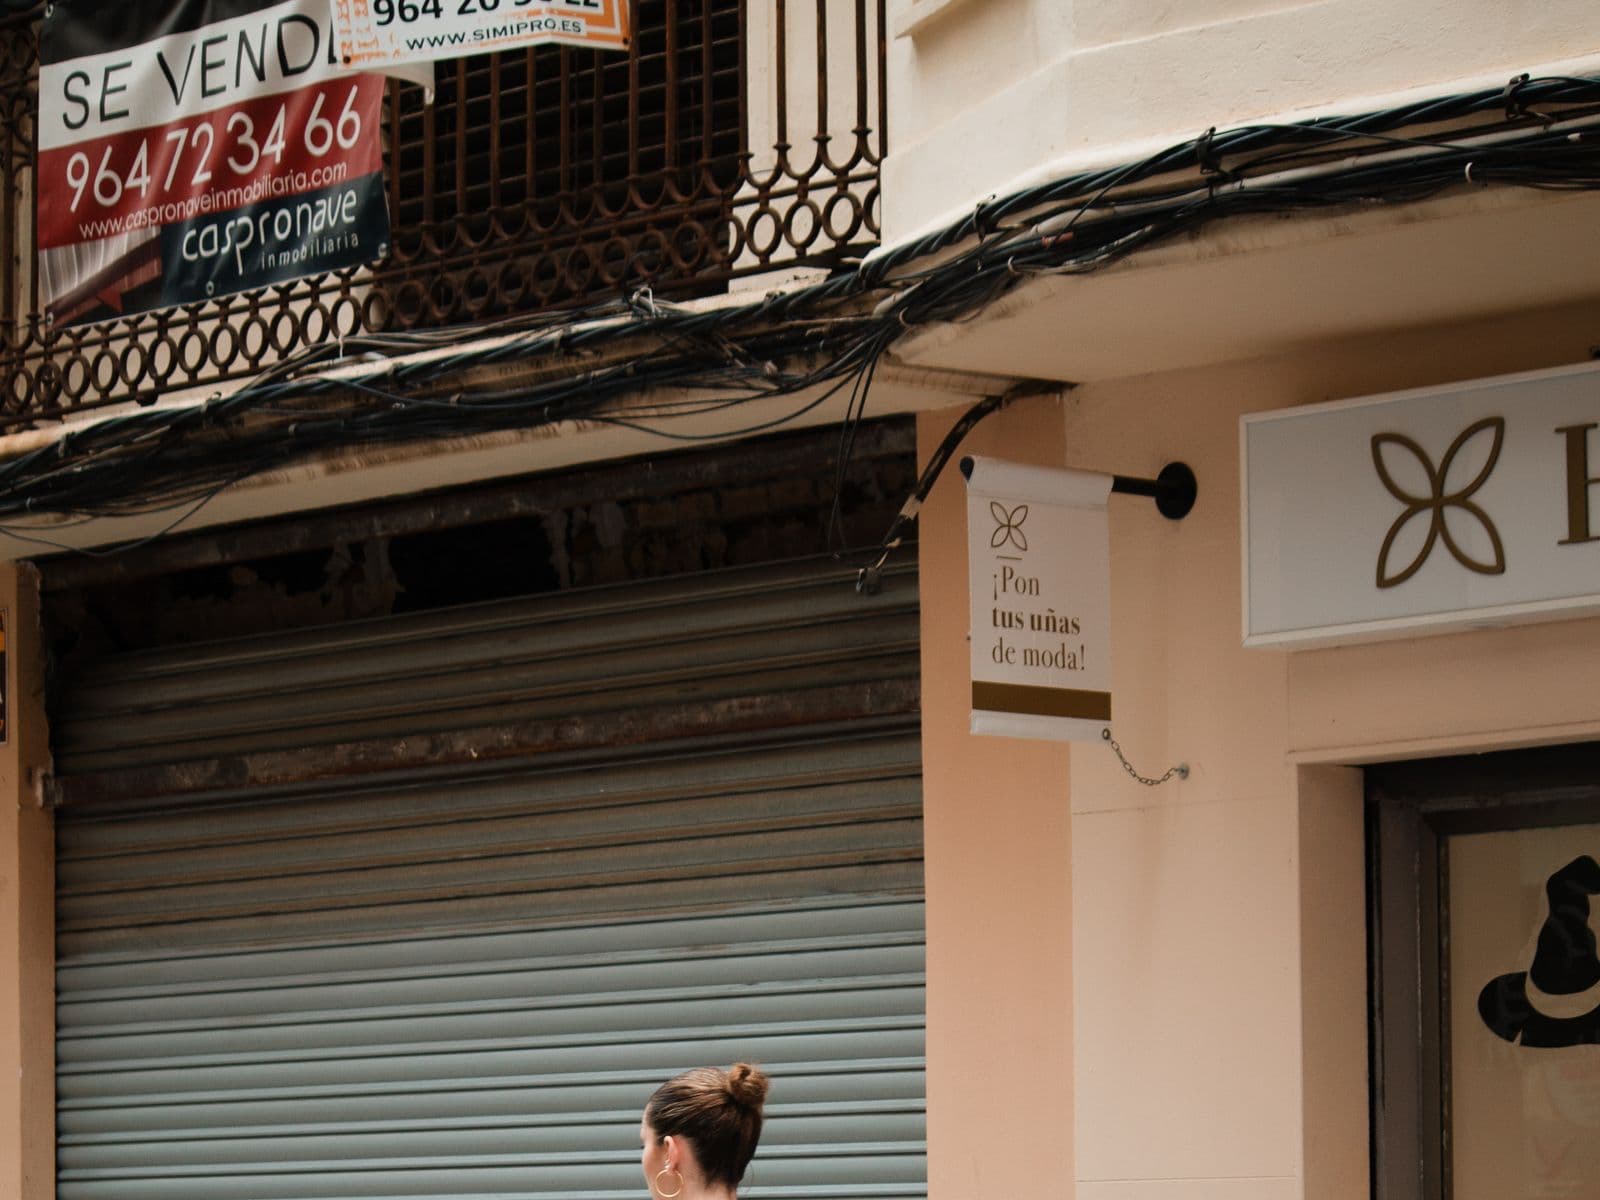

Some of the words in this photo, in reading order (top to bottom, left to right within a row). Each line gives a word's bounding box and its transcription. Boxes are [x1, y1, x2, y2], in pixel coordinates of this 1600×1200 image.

[63, 61, 132, 129] SE
[157, 14, 337, 105] VEND
[67, 138, 150, 212] 964
[164, 123, 214, 191] 72
[227, 103, 286, 174] 34
[304, 85, 361, 157] 66
[79, 161, 347, 239] www.caspronaveinmobiliaria.com
[183, 190, 357, 275] caspronave
[261, 231, 359, 270] inmobiliaria
[993, 565, 1040, 601] ¡Pon
[992, 607, 1024, 630] tus
[1030, 608, 1080, 635] uñas
[992, 636, 1016, 665] de
[1023, 642, 1085, 671] moda!
